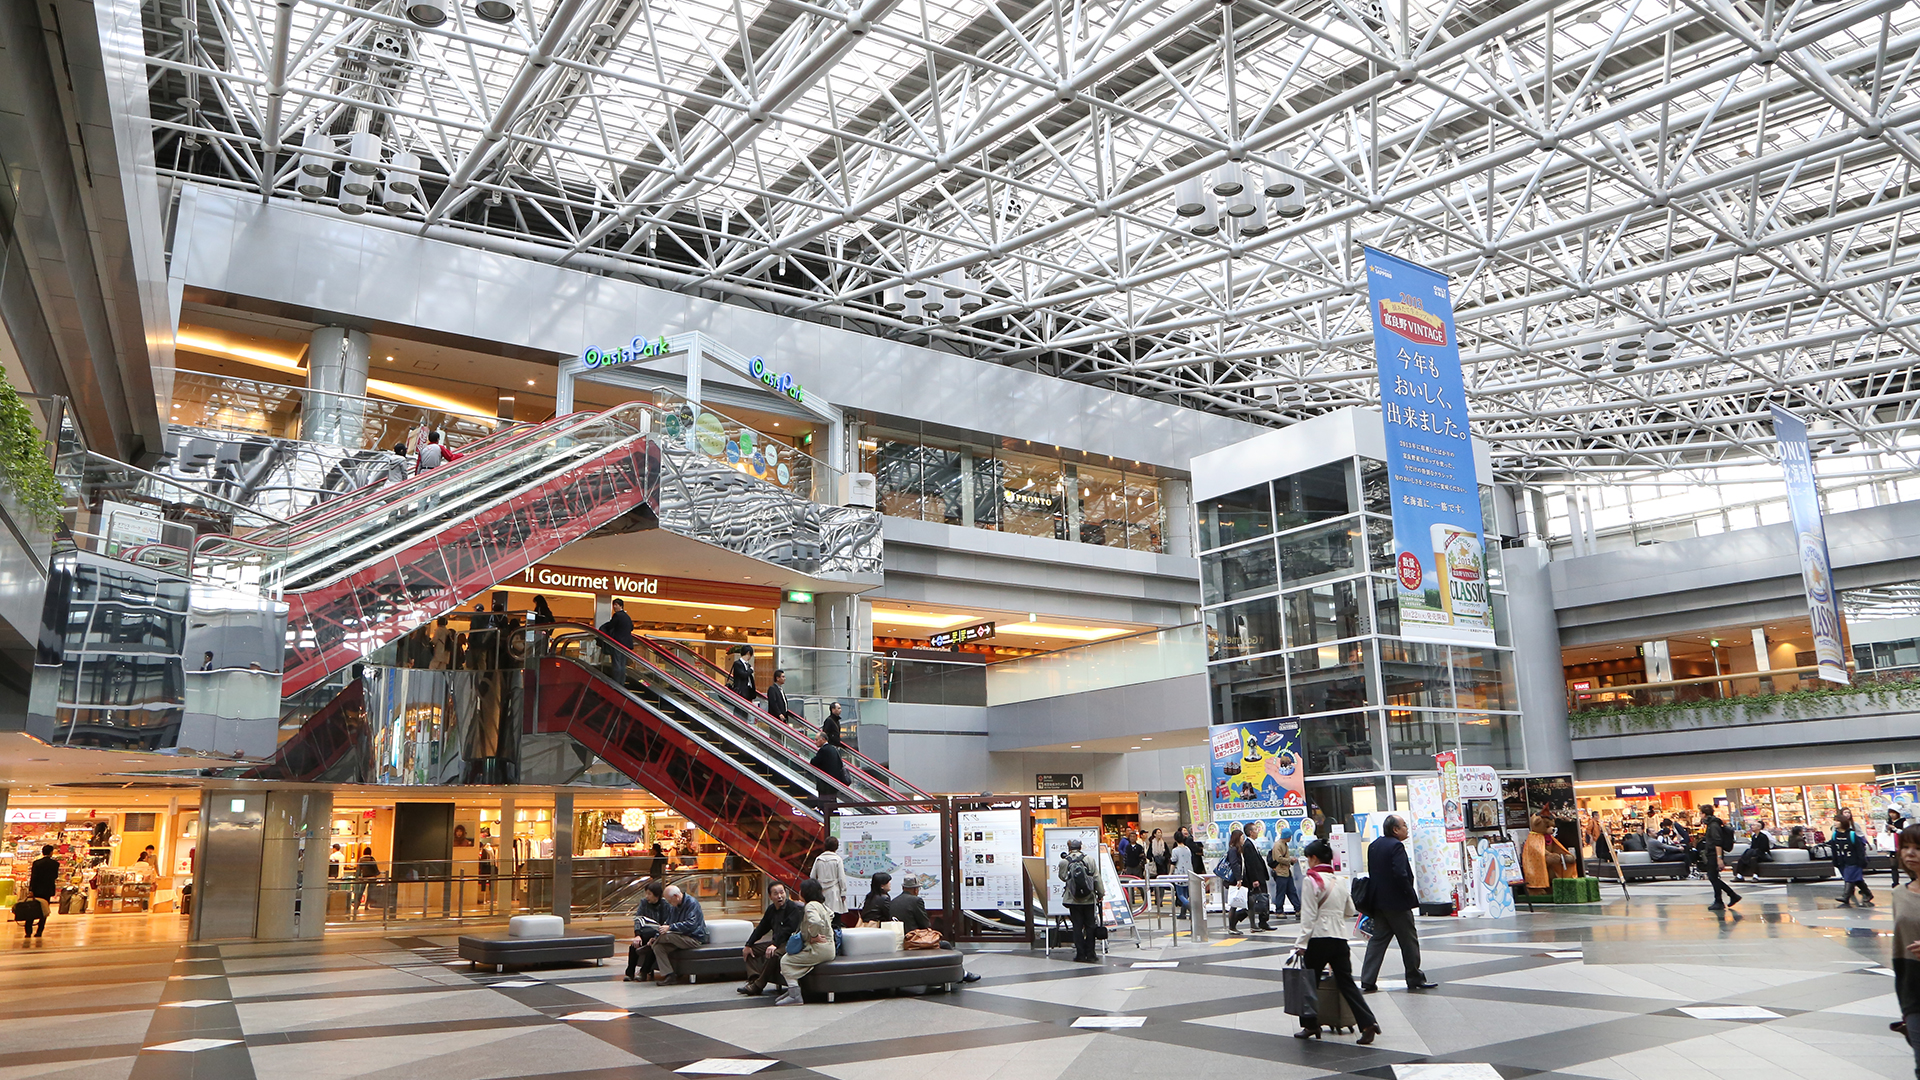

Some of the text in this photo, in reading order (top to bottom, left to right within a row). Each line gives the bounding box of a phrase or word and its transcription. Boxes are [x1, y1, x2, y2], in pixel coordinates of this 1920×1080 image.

[1399, 292, 1424, 311] 2013
[582, 334, 670, 369] Oasis Park
[1396, 347, 1440, 378] 今年も
[1394, 374, 1452, 410] おいしく、
[1386, 402, 1466, 440] 出来ました。
[1778, 440, 1806, 460] ONLY
[1016, 494, 1052, 506] PRONTO
[538, 568, 658, 594] Gourmet World
[1403, 568, 1416, 580] 限定
[1450, 580, 1486, 602] CLASSIC
